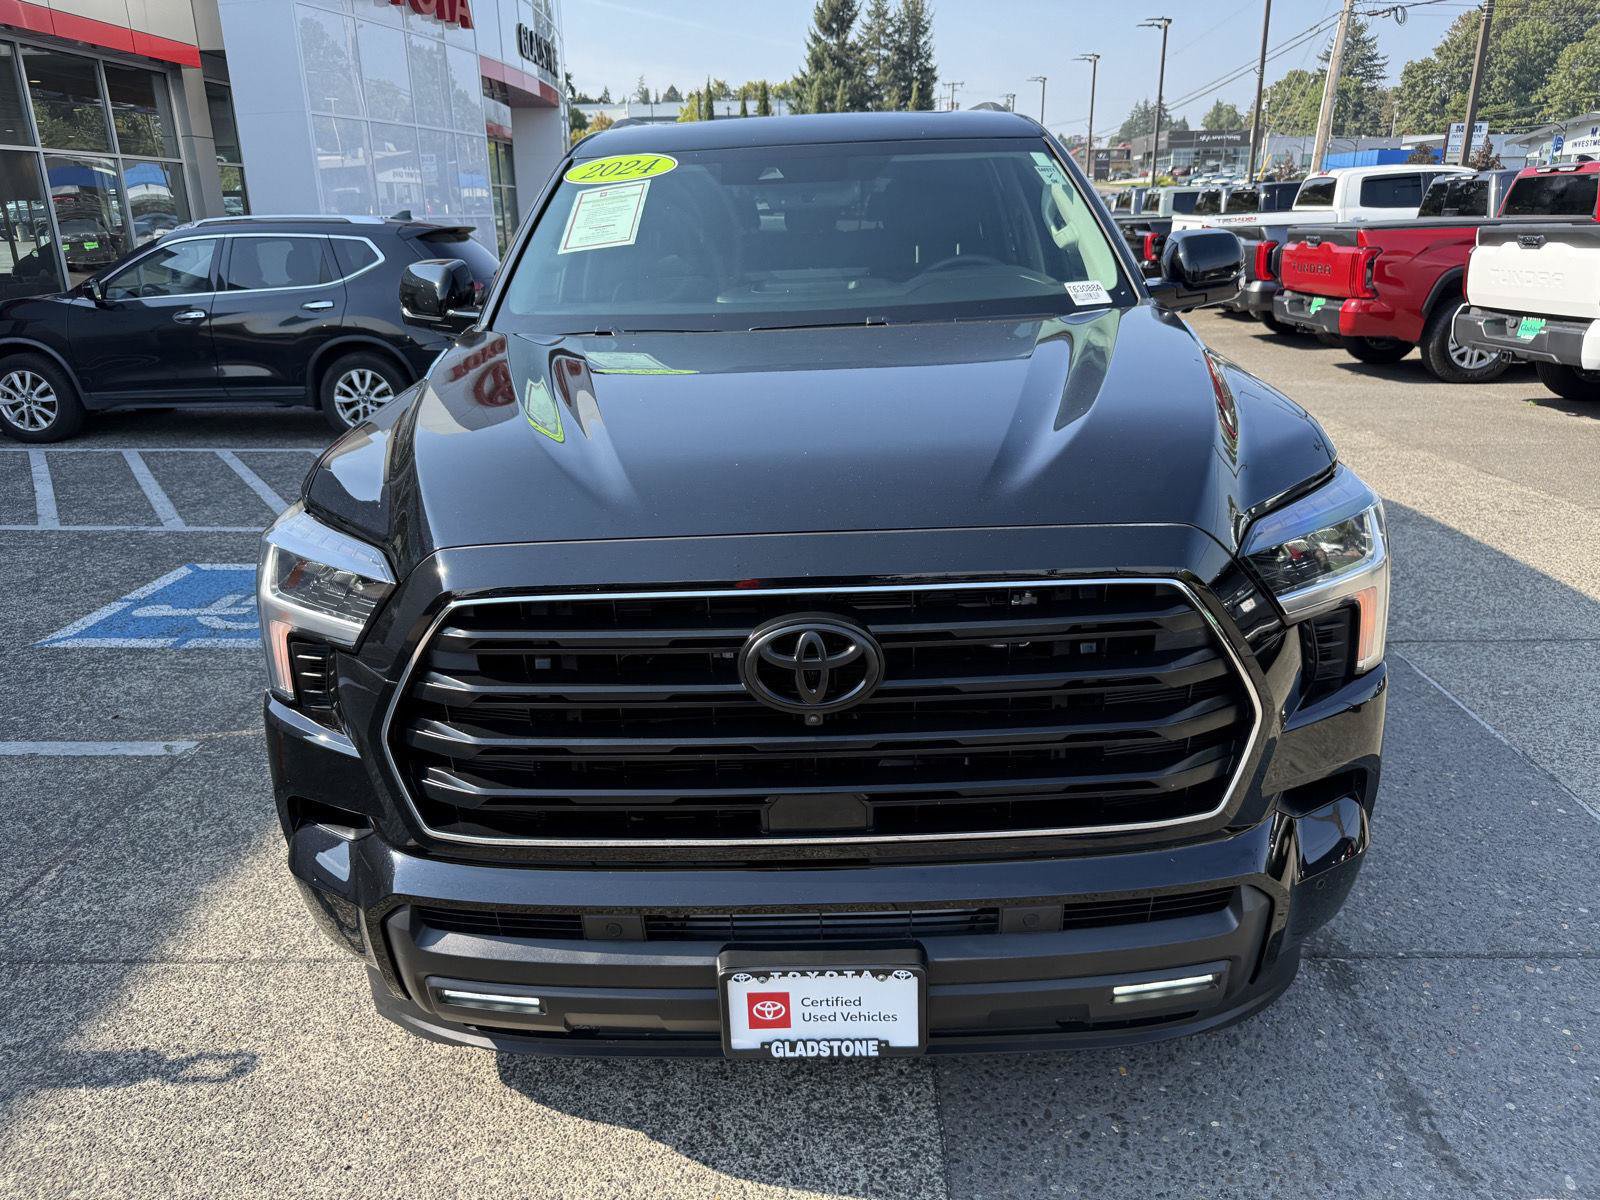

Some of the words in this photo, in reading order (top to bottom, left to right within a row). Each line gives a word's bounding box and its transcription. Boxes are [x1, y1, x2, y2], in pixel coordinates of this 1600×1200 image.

[578, 158, 661, 180] 2024
[1292, 262, 1332, 275] TUNDRA
[770, 970, 876, 980] TOYOTA
[801, 997, 862, 1008] Certified
[802, 1012, 837, 1022] Used
[840, 1011, 898, 1022] Vehicles
[770, 1040, 879, 1058] GLADSTONE
